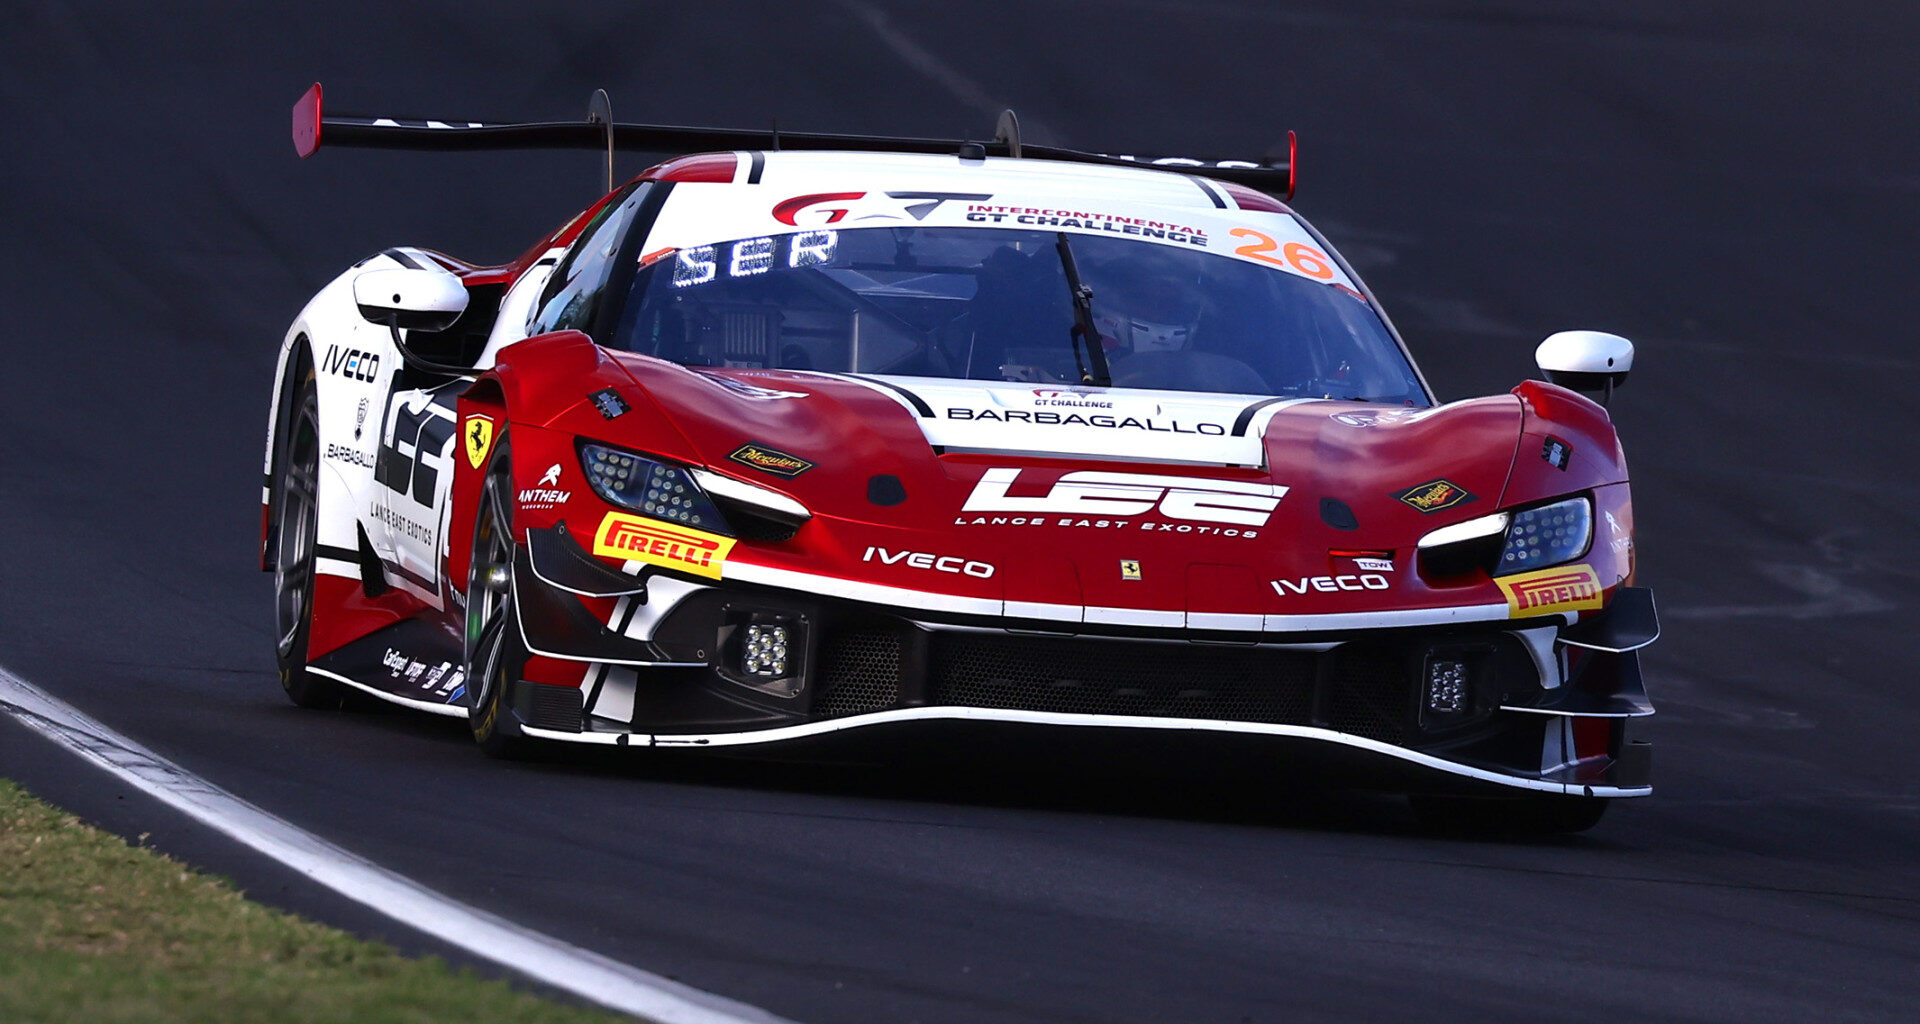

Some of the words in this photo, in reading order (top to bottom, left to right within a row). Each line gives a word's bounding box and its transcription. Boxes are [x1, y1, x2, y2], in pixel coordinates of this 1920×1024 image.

[966, 212, 1008, 224] GT
[1017, 214, 1209, 247] CHALLENGE
[968, 205, 1208, 237] INTERCONTINENTAL
[676, 230, 838, 287] SER
[1229, 228, 1334, 279] 26
[322, 344, 379, 383] IVECO
[1051, 399, 1113, 408] CHALLENGE
[947, 408, 1226, 436] BARBAGALLO
[327, 443, 375, 469] BARBAGALLO
[518, 489, 571, 503] ANTHEM
[961, 467, 1290, 526] LEE
[370, 501, 391, 525] LANCE
[391, 512, 406, 533] EAST
[407, 520, 432, 546] EXOTICS
[955, 517, 1046, 526] LANCE
[1058, 519, 1129, 529] EAST
[1141, 522, 1258, 540] EXOTICS
[604, 520, 720, 567] PIRELLI
[863, 546, 995, 579] IVECO
[1270, 574, 1390, 596] IVECO
[1509, 572, 1596, 610] PIRELLI
